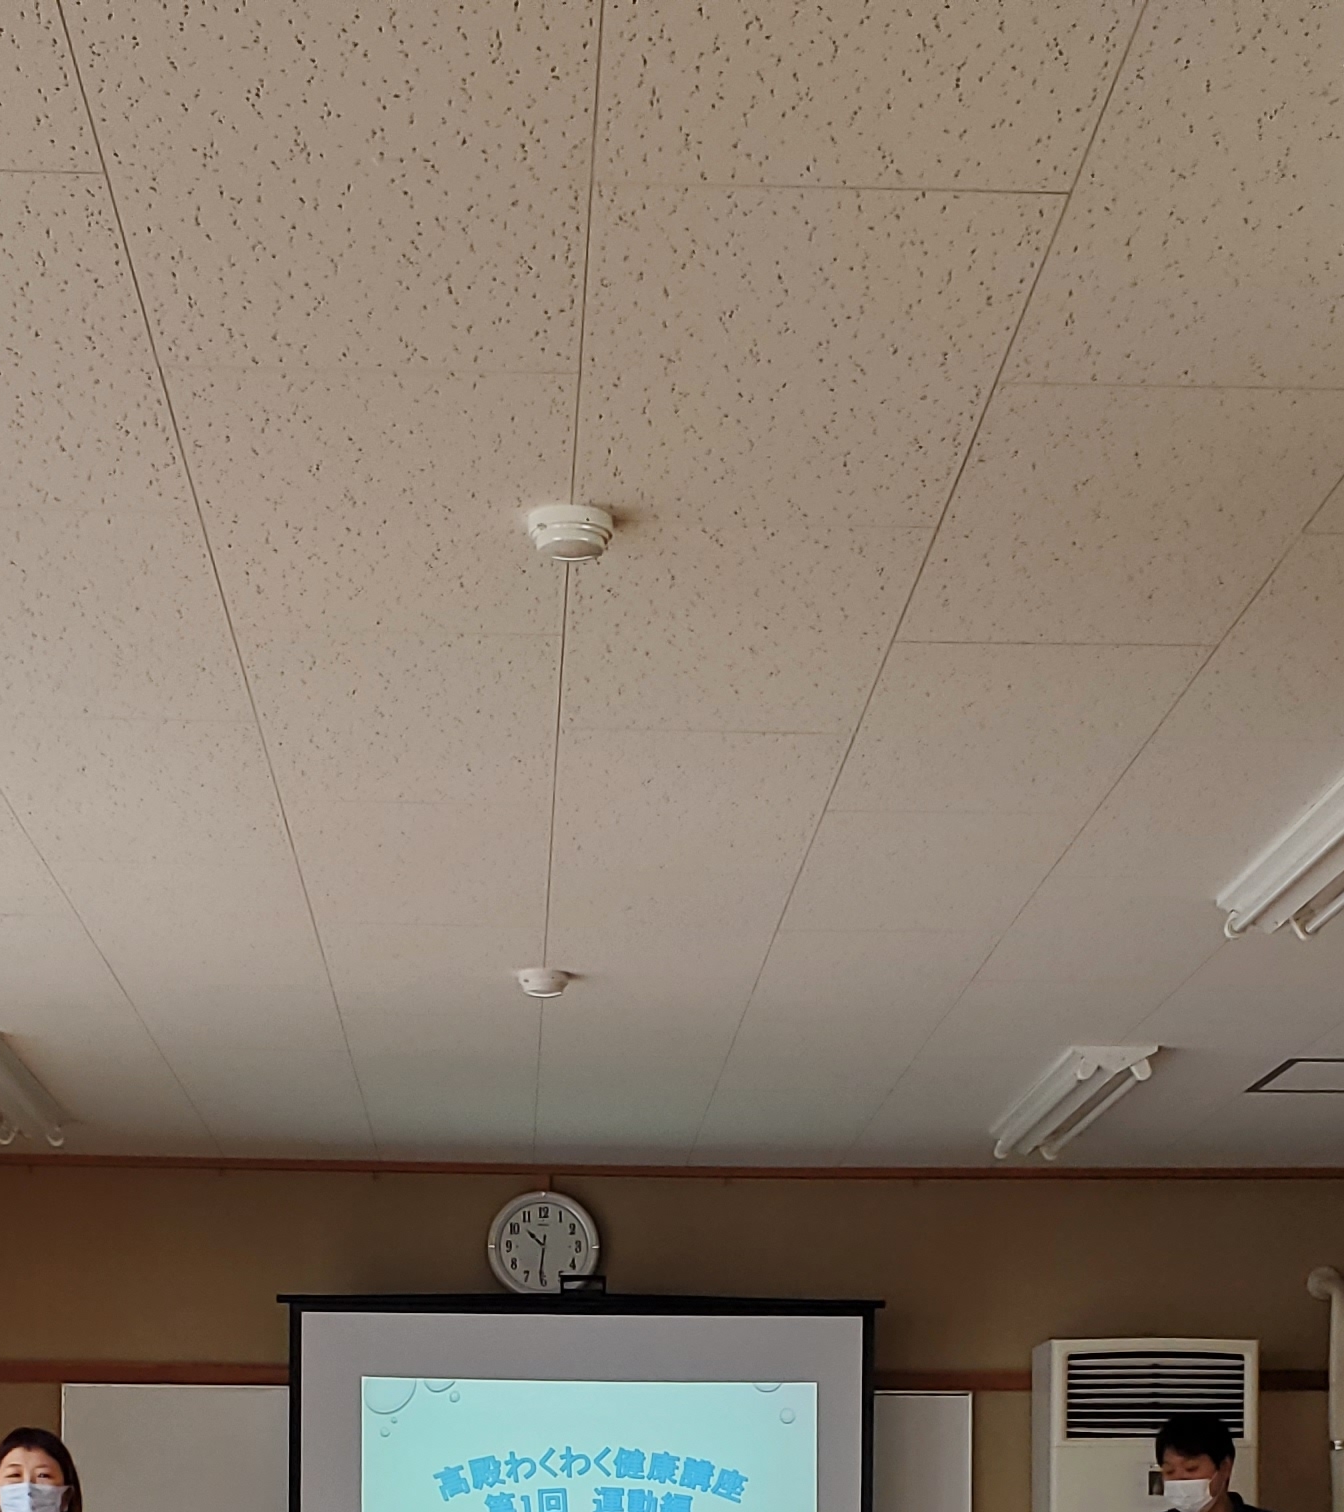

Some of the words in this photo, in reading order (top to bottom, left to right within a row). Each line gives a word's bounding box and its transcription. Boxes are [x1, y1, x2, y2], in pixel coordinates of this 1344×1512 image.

[522, 1210, 531, 1223] 11
[538, 1206, 549, 1218] 12
[558, 1210, 563, 1223] 1
[509, 1222, 520, 1235] 10
[569, 1223, 576, 1235] 2
[506, 1240, 512, 1252] 9
[575, 1241, 582, 1253] 3
[510, 1258, 518, 1270] 8
[569, 1257, 576, 1270] 4
[523, 1271, 530, 1283] 7
[433, 1446, 749, 1504] 高殿わくわく健康講座
